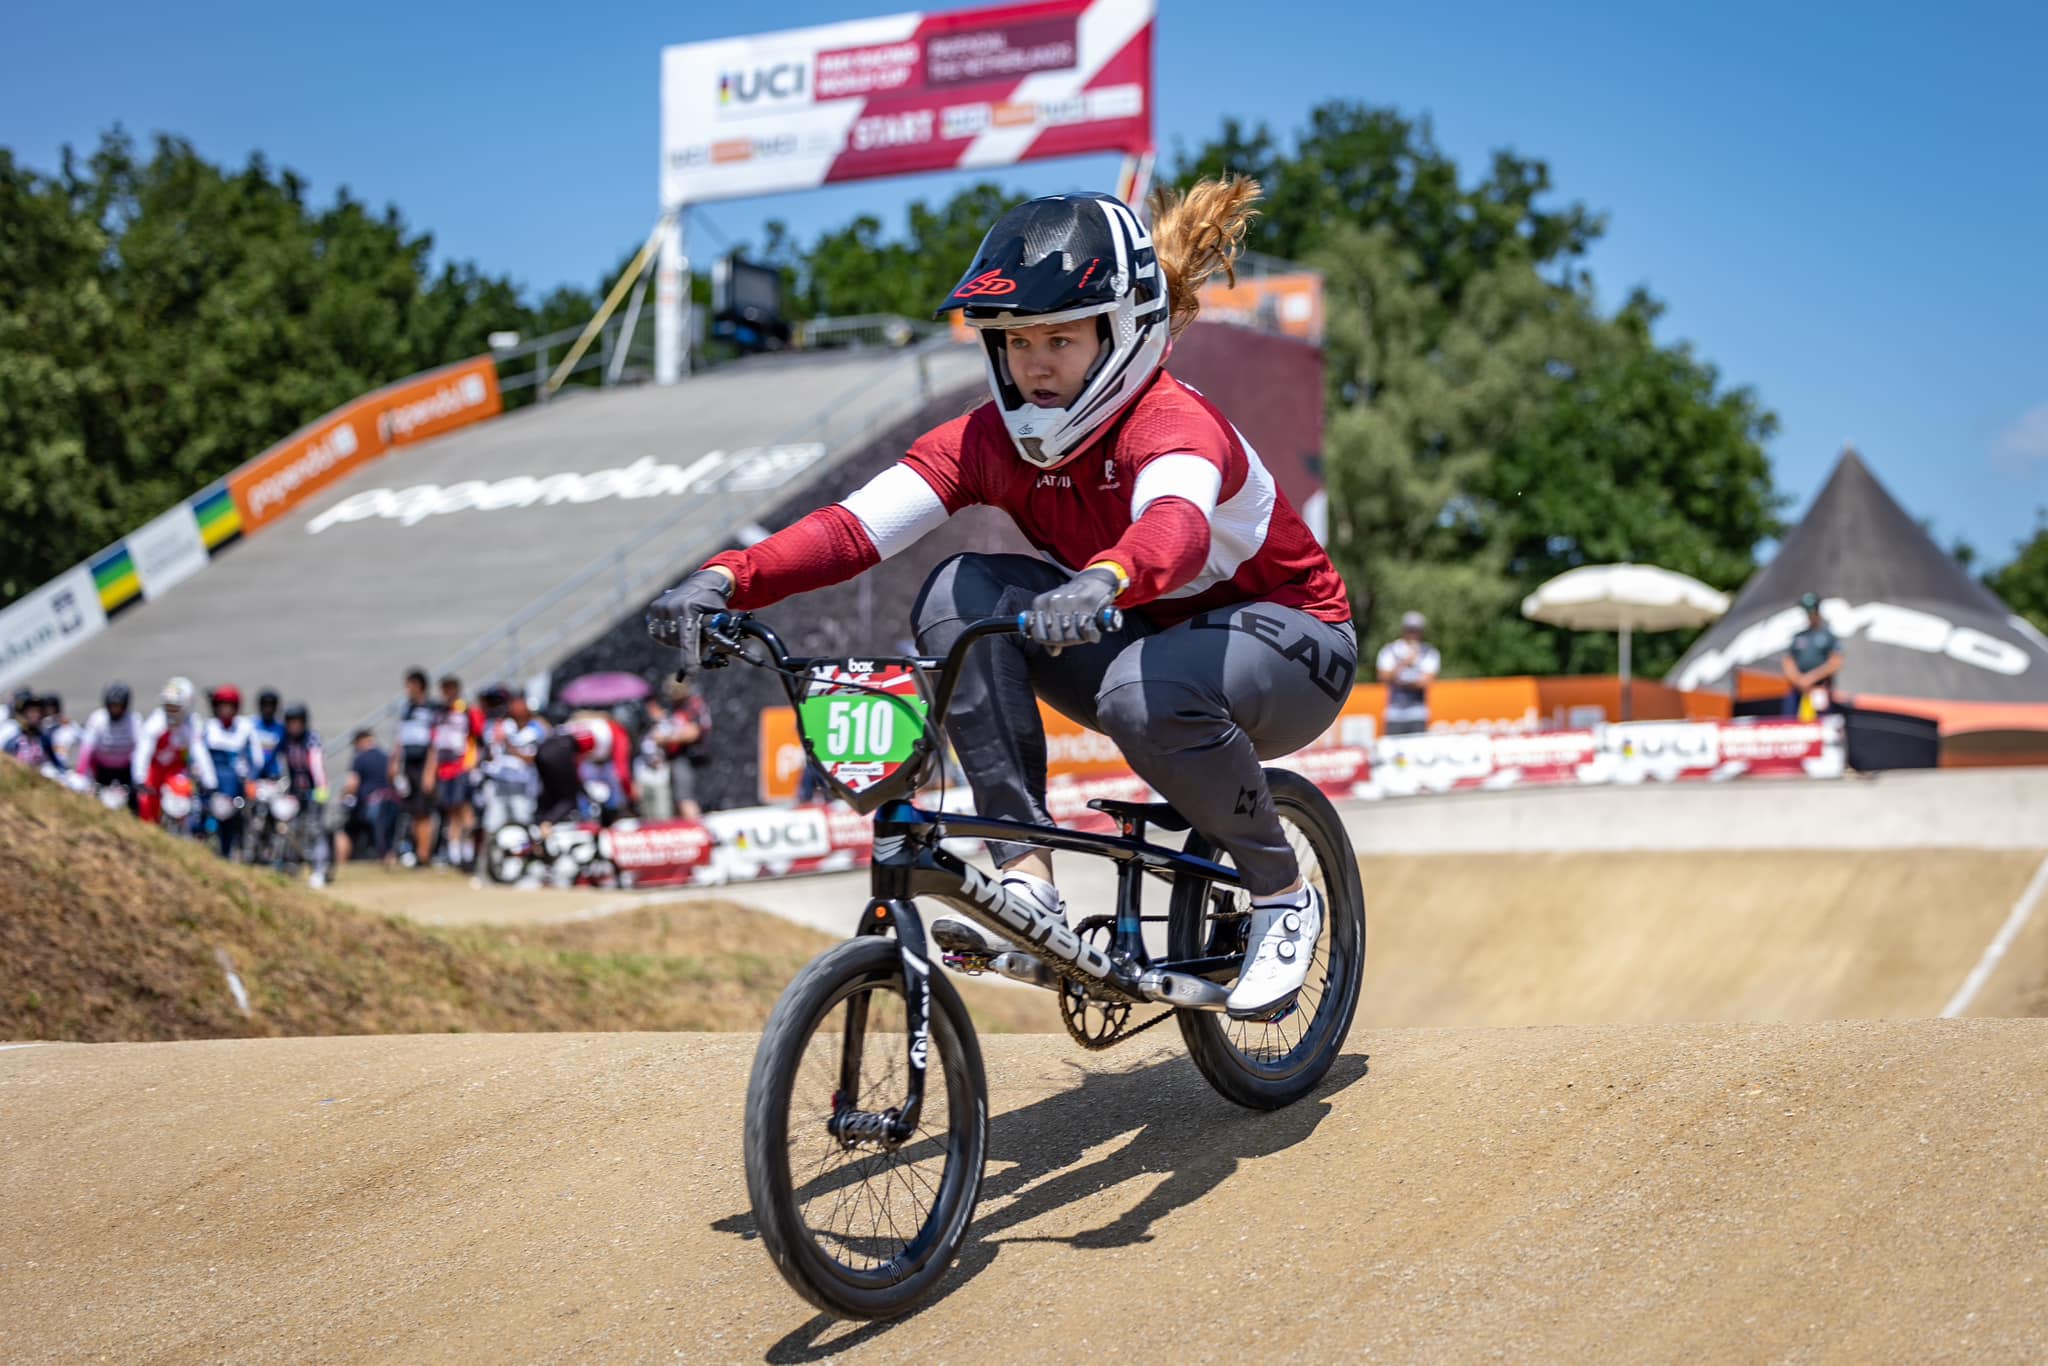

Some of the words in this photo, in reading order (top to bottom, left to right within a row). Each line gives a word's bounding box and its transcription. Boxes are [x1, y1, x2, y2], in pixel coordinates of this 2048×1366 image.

[735, 64, 807, 104] UCI
[853, 110, 936, 150] START
[848, 658, 875, 673] box
[1190, 610, 1354, 704] LEAD
[827, 700, 894, 756] 510
[753, 821, 819, 849] UCI
[960, 863, 1111, 978] MEYBO
